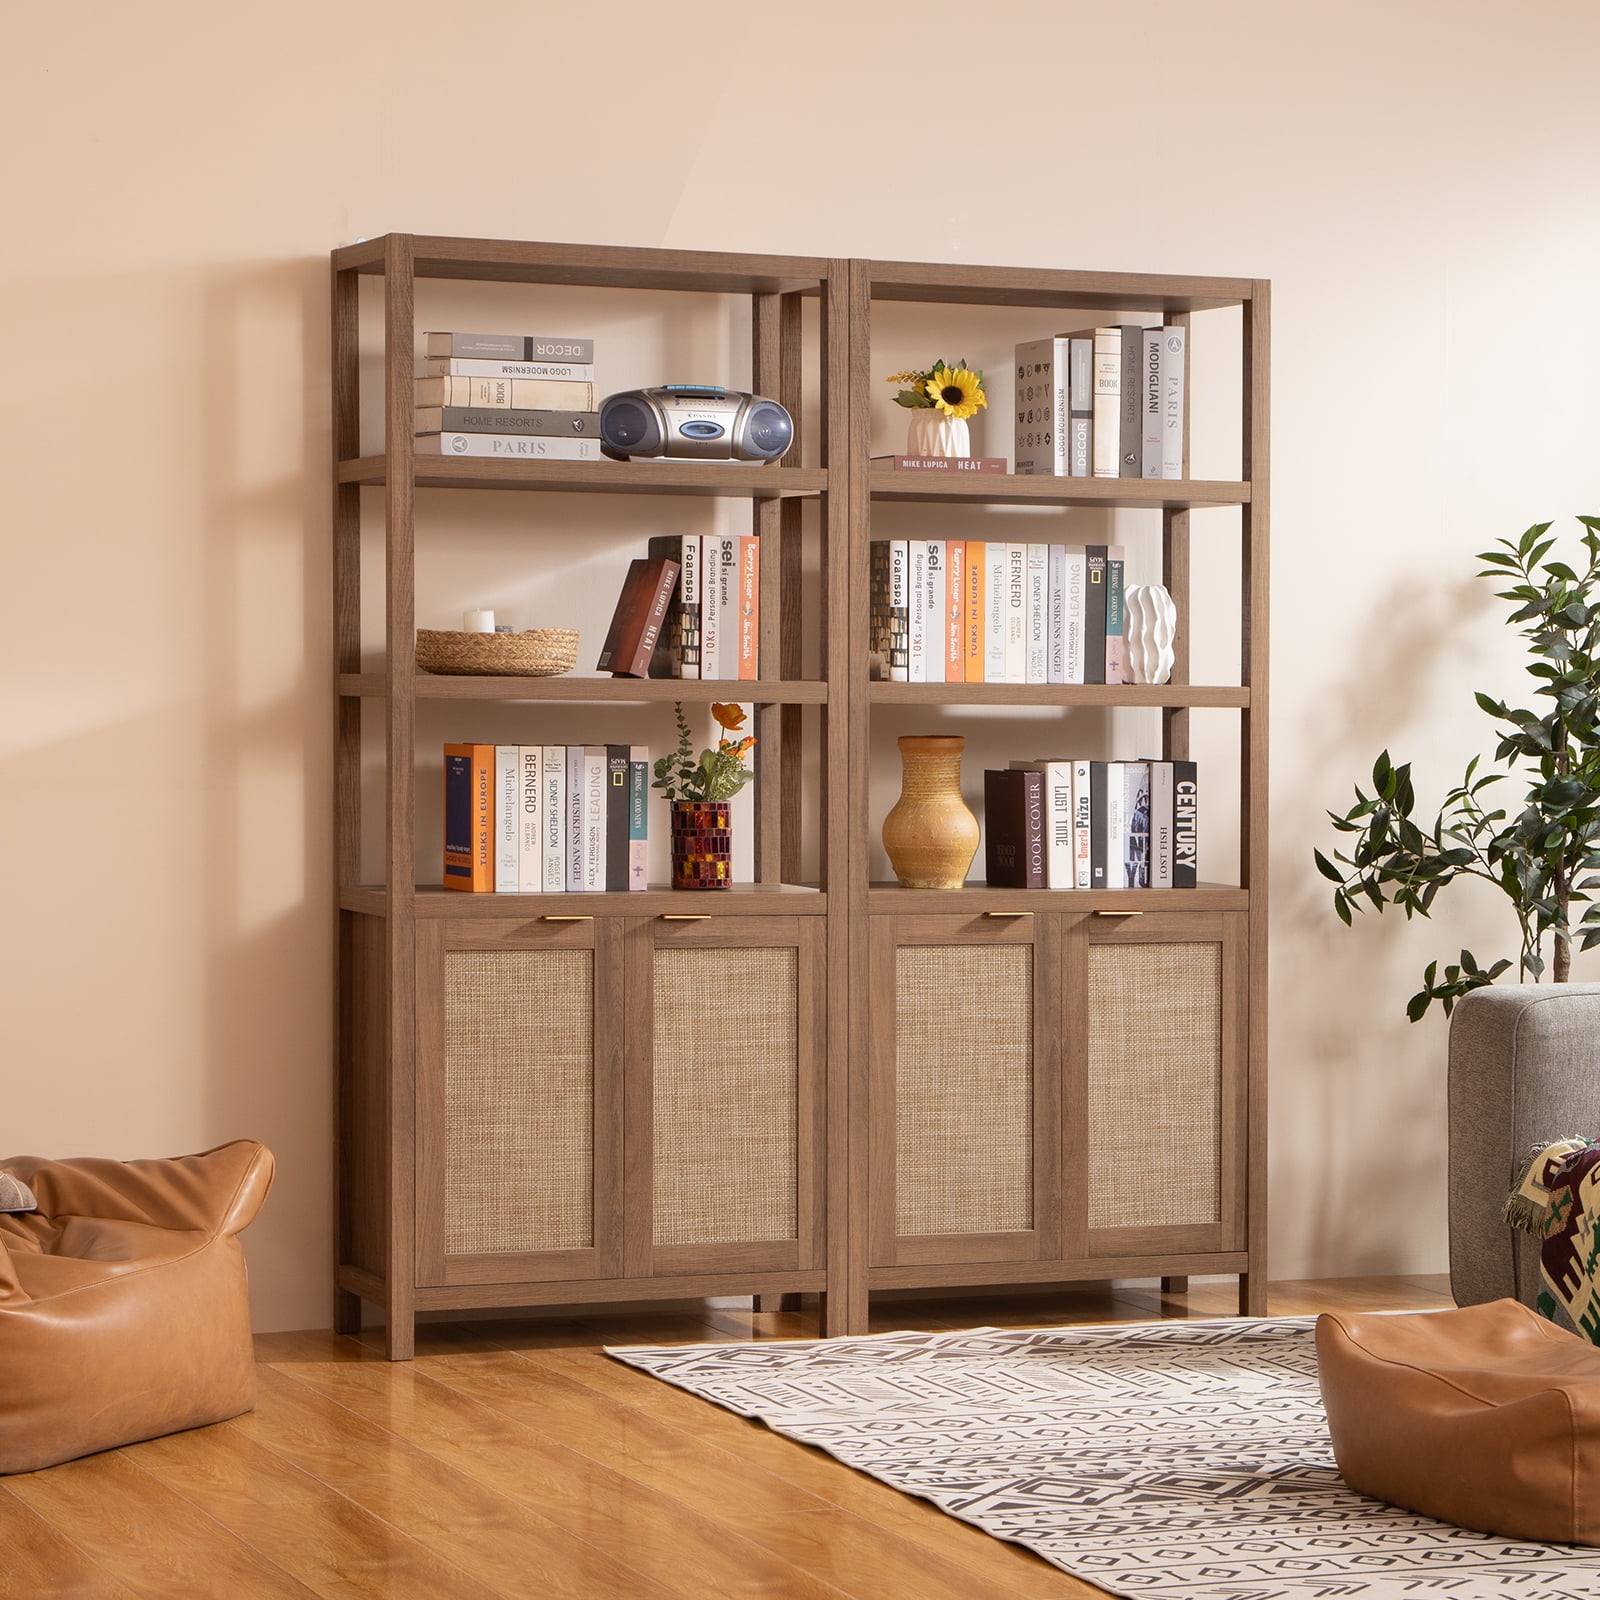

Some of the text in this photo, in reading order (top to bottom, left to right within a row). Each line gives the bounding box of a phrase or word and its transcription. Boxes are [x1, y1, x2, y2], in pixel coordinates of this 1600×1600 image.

[536, 344, 581, 356] DECOR
[502, 366, 572, 375] LOGO MODERNISM
[1099, 379, 1119, 388] BOOK
[1148, 342, 1160, 414] MODIGLIANI
[496, 382, 505, 404] BOOK
[1168, 376, 1179, 429] PARIS
[463, 416, 543, 427] HOME RESORTS
[492, 440, 546, 454] PARIS
[1077, 422, 1087, 466] DECOR
[958, 461, 981, 470] HEAT
[709, 549, 717, 584] Branding
[722, 540, 736, 566] sei
[747, 544, 756, 572] Barry
[928, 545, 941, 570] sei
[953, 548, 962, 576] Barry
[685, 544, 696, 601] Foamspa
[894, 550, 903, 605] Foamspa
[915, 554, 924, 589] Branding
[1011, 551, 1022, 608] BERNERD
[1033, 576, 1041, 602] SIDNEY
[708, 585, 717, 620] Personal
[720, 577, 728, 606] grande
[991, 564, 1002, 634] Michelangelo
[1070, 564, 1080, 616] LEADING
[643, 571, 674, 651] MIKE LUPICA HEAT
[971, 609, 978, 620] IN
[1033, 604, 1041, 641] SHELDON
[706, 630, 715, 654] 10Ks
[913, 633, 922, 657] 10Ks
[525, 754, 536, 813] BERNERD
[550, 779, 558, 808] SIDNEY
[590, 767, 601, 821] LEADING
[480, 815, 487, 827] IN
[504, 768, 515, 841] Michelangelo
[572, 793, 580, 845] MUSIKENS
[550, 809, 558, 848] SHELDON
[1030, 783, 1042, 874] BOOK COVER
[1176, 781, 1196, 868] CENTURY
[554, 876, 560, 886] OF
[572, 848, 581, 884] ANGEL
